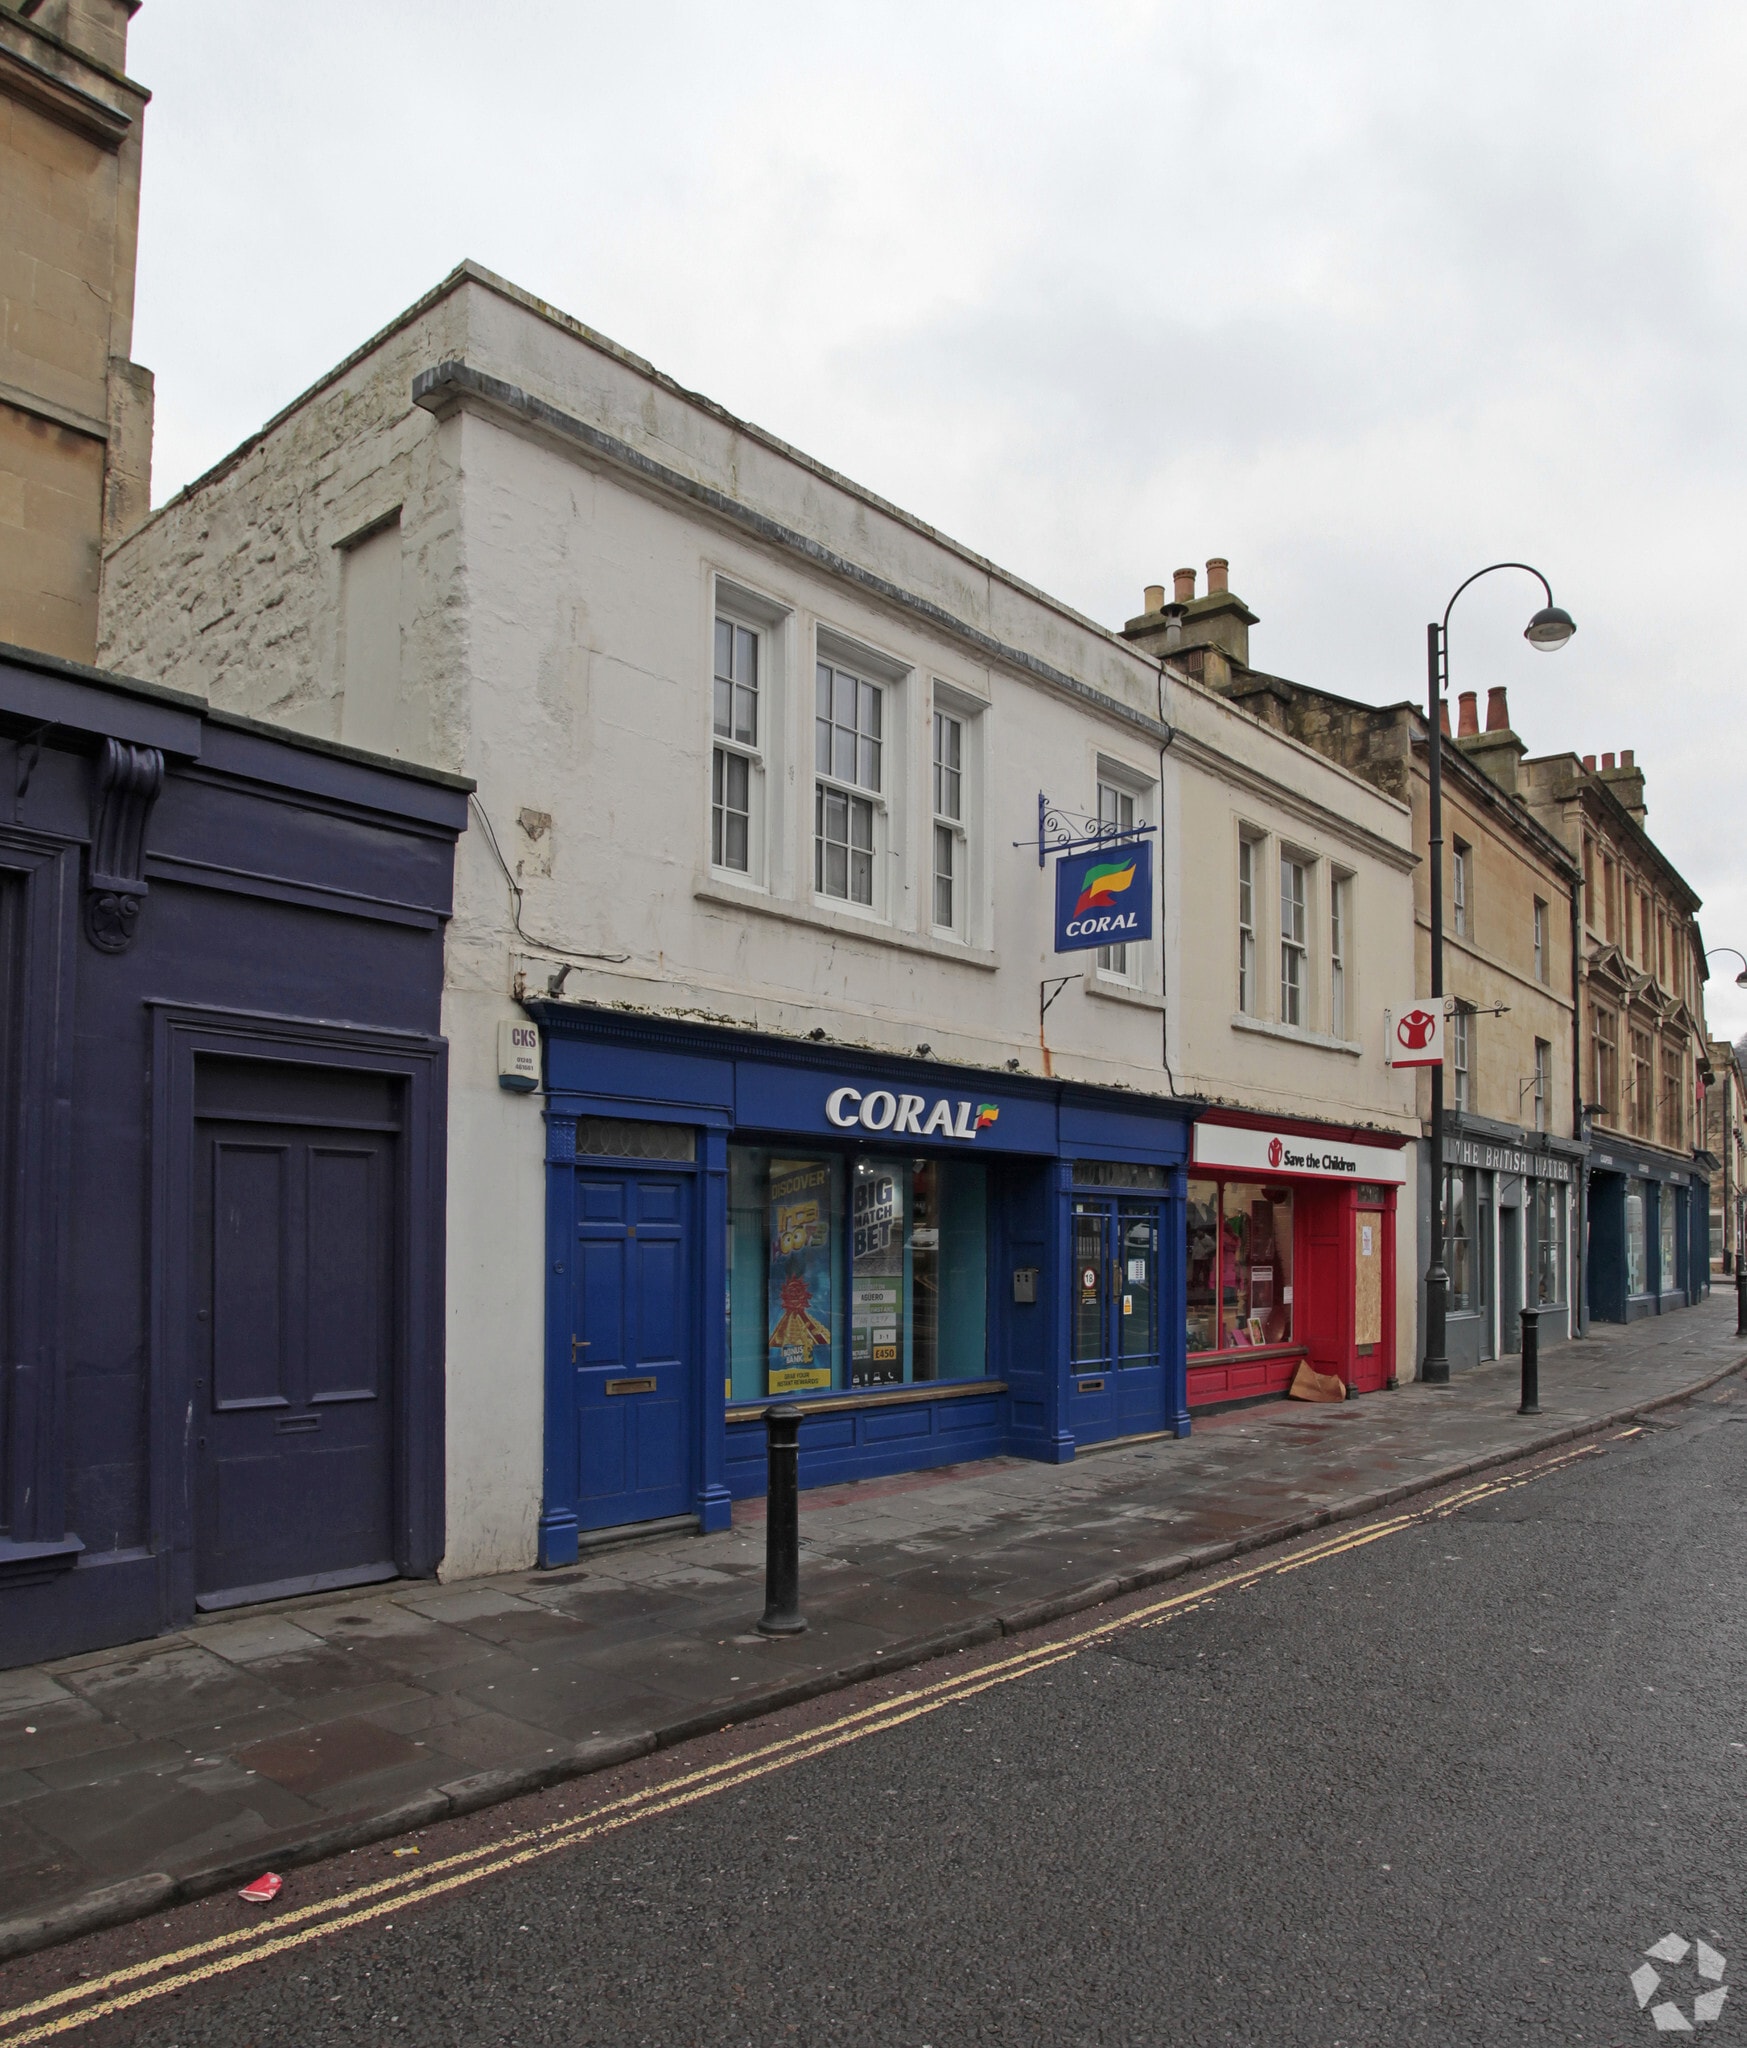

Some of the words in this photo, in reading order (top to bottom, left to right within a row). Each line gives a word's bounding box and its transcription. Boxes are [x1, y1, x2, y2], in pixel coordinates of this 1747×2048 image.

[1066, 912, 1138, 937] CORAL
[512, 1028, 536, 1048] CKS
[826, 1087, 977, 1138] CORAL
[1284, 1150, 1304, 1167] Save
[1306, 1153, 1320, 1169] the
[1322, 1155, 1356, 1172] Children
[1485, 1147, 1527, 1172] BRITISH
[771, 1170, 825, 1200] DISCOVER
[854, 1177, 893, 1216] BIG
[854, 1205, 893, 1229] MATCH
[854, 1221, 893, 1259] BET
[1085, 1273, 1094, 1283] 18
[783, 1345, 803, 1357] BONUS
